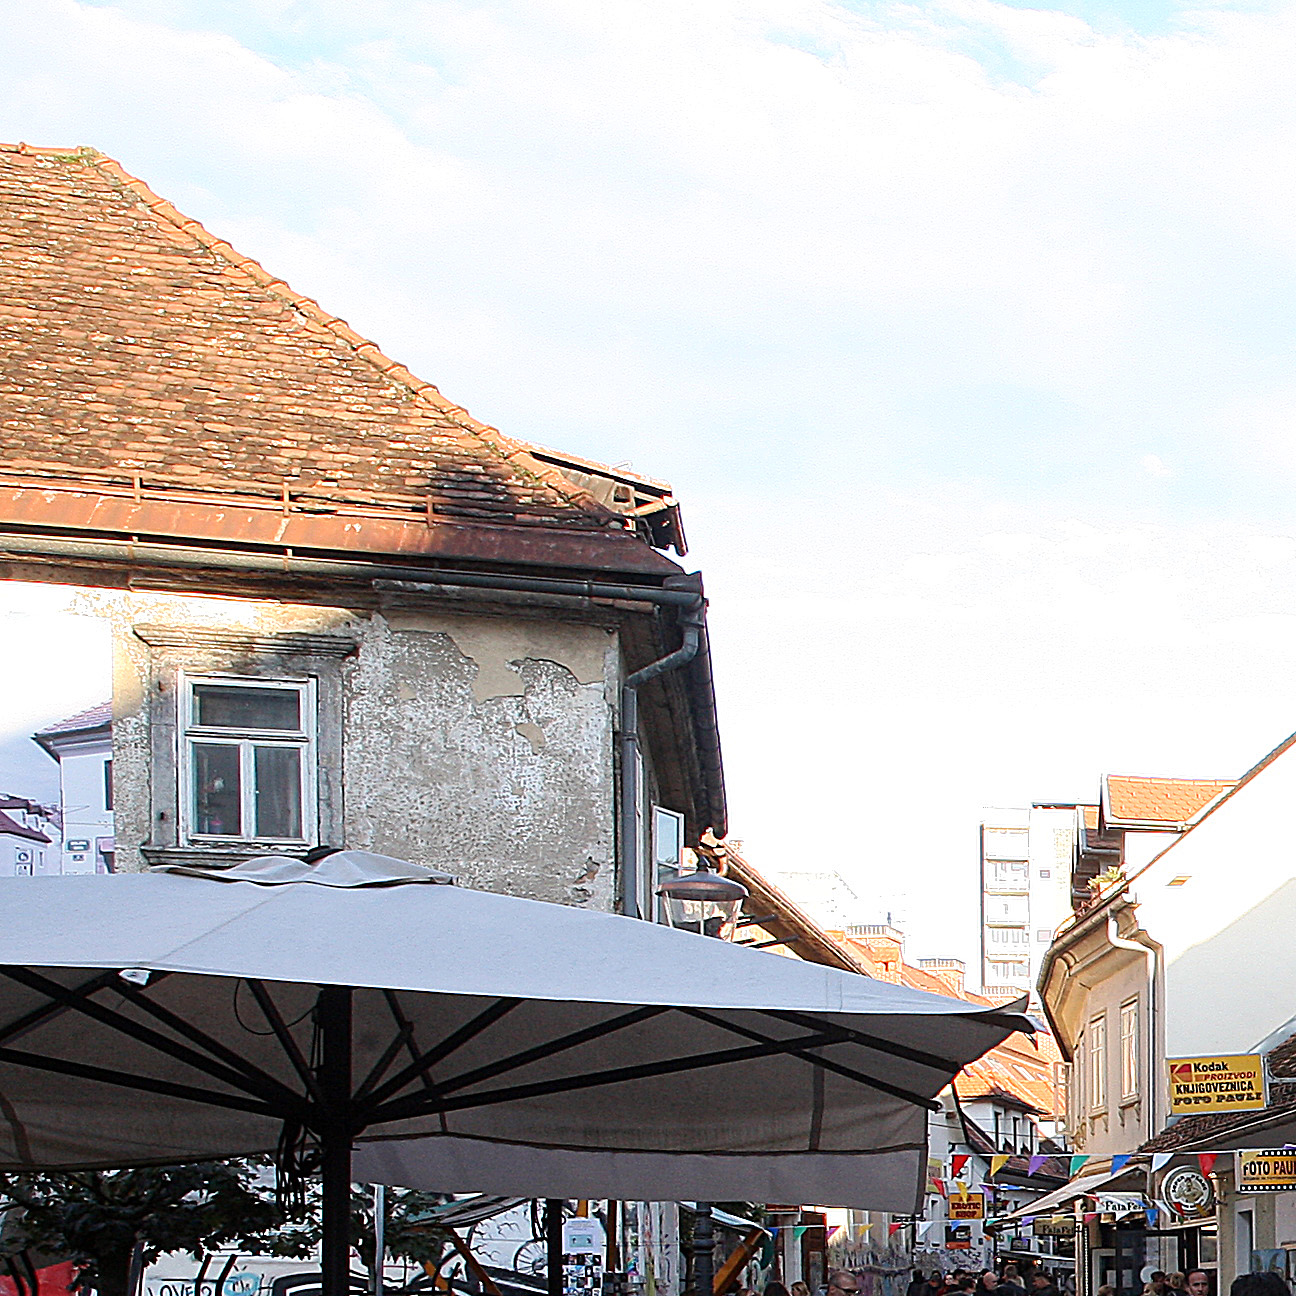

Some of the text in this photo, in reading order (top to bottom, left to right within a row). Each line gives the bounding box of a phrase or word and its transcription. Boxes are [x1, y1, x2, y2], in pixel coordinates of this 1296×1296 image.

[1193, 1061, 1229, 1072] Kodak
[1204, 1071, 1256, 1080] PROIZVODI
[1176, 1081, 1254, 1094] KNJIGOVEZNICA
[1173, 1092, 1262, 1105] FOTO PAULI
[1243, 1161, 1271, 1176] FOTO
